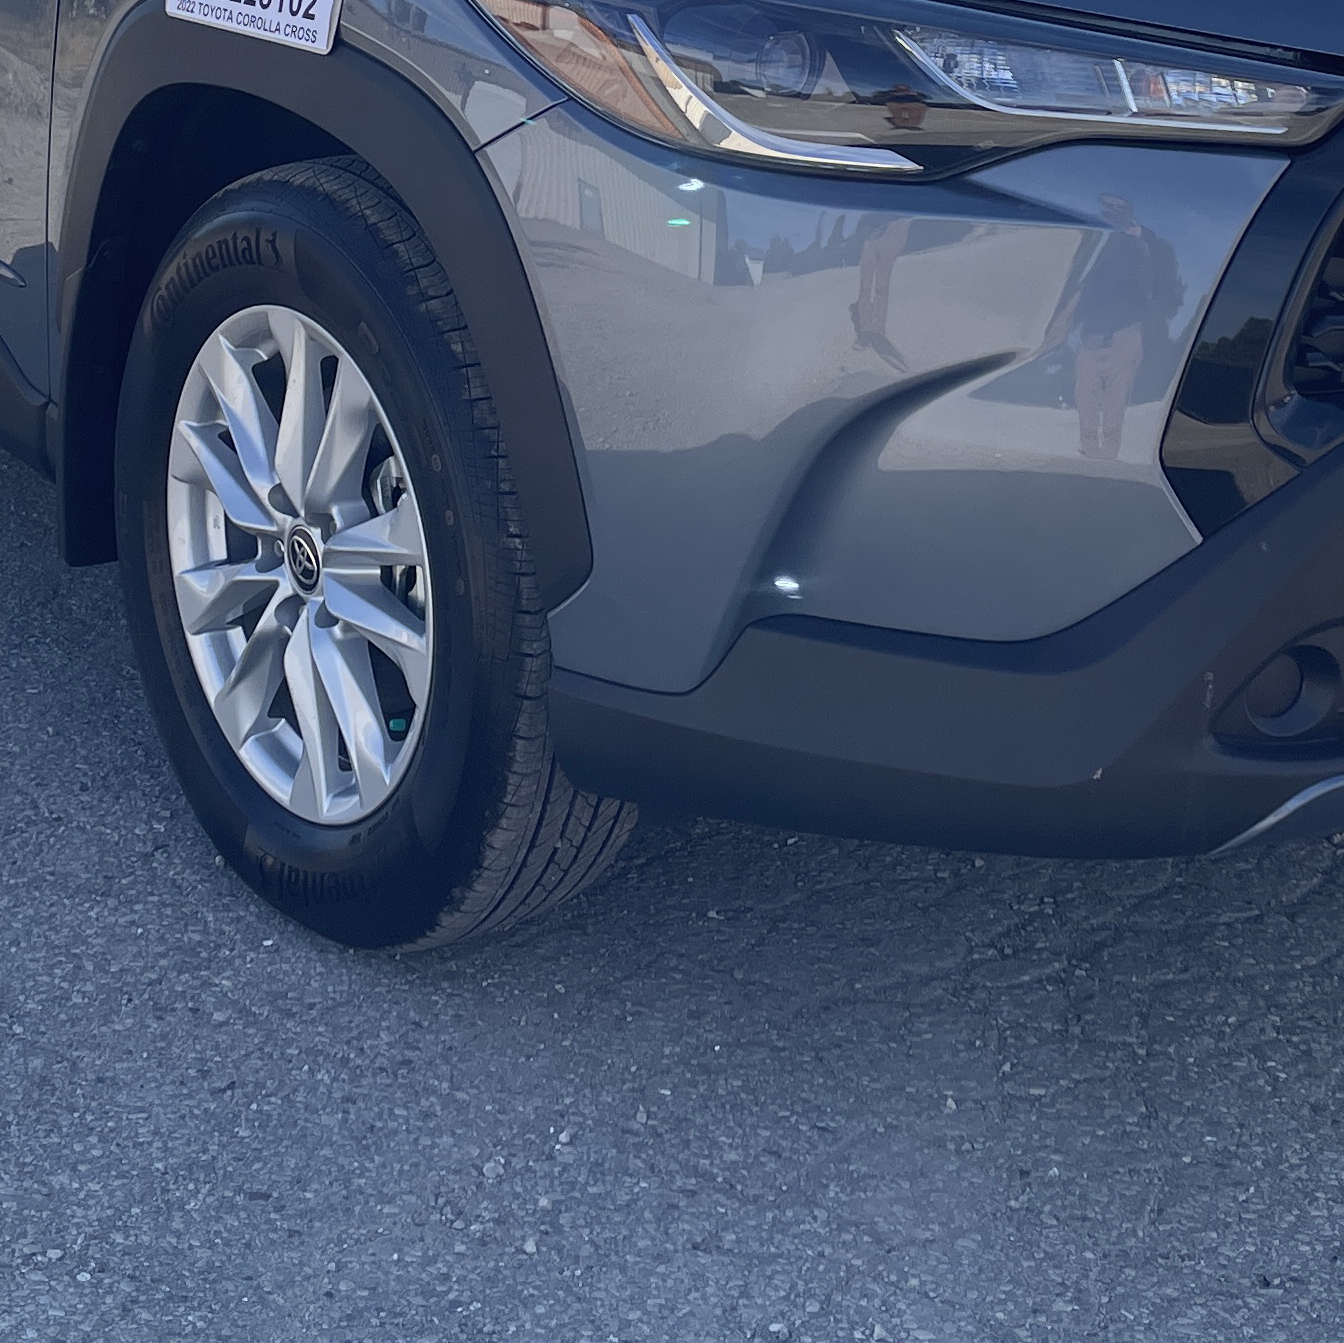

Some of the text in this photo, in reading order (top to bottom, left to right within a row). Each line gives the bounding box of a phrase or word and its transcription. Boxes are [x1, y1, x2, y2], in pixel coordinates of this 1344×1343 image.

[198, 2, 234, 23] TOYOTA
[236, 11, 281, 34] COROLLA
[284, 23, 318, 44] CROSS
